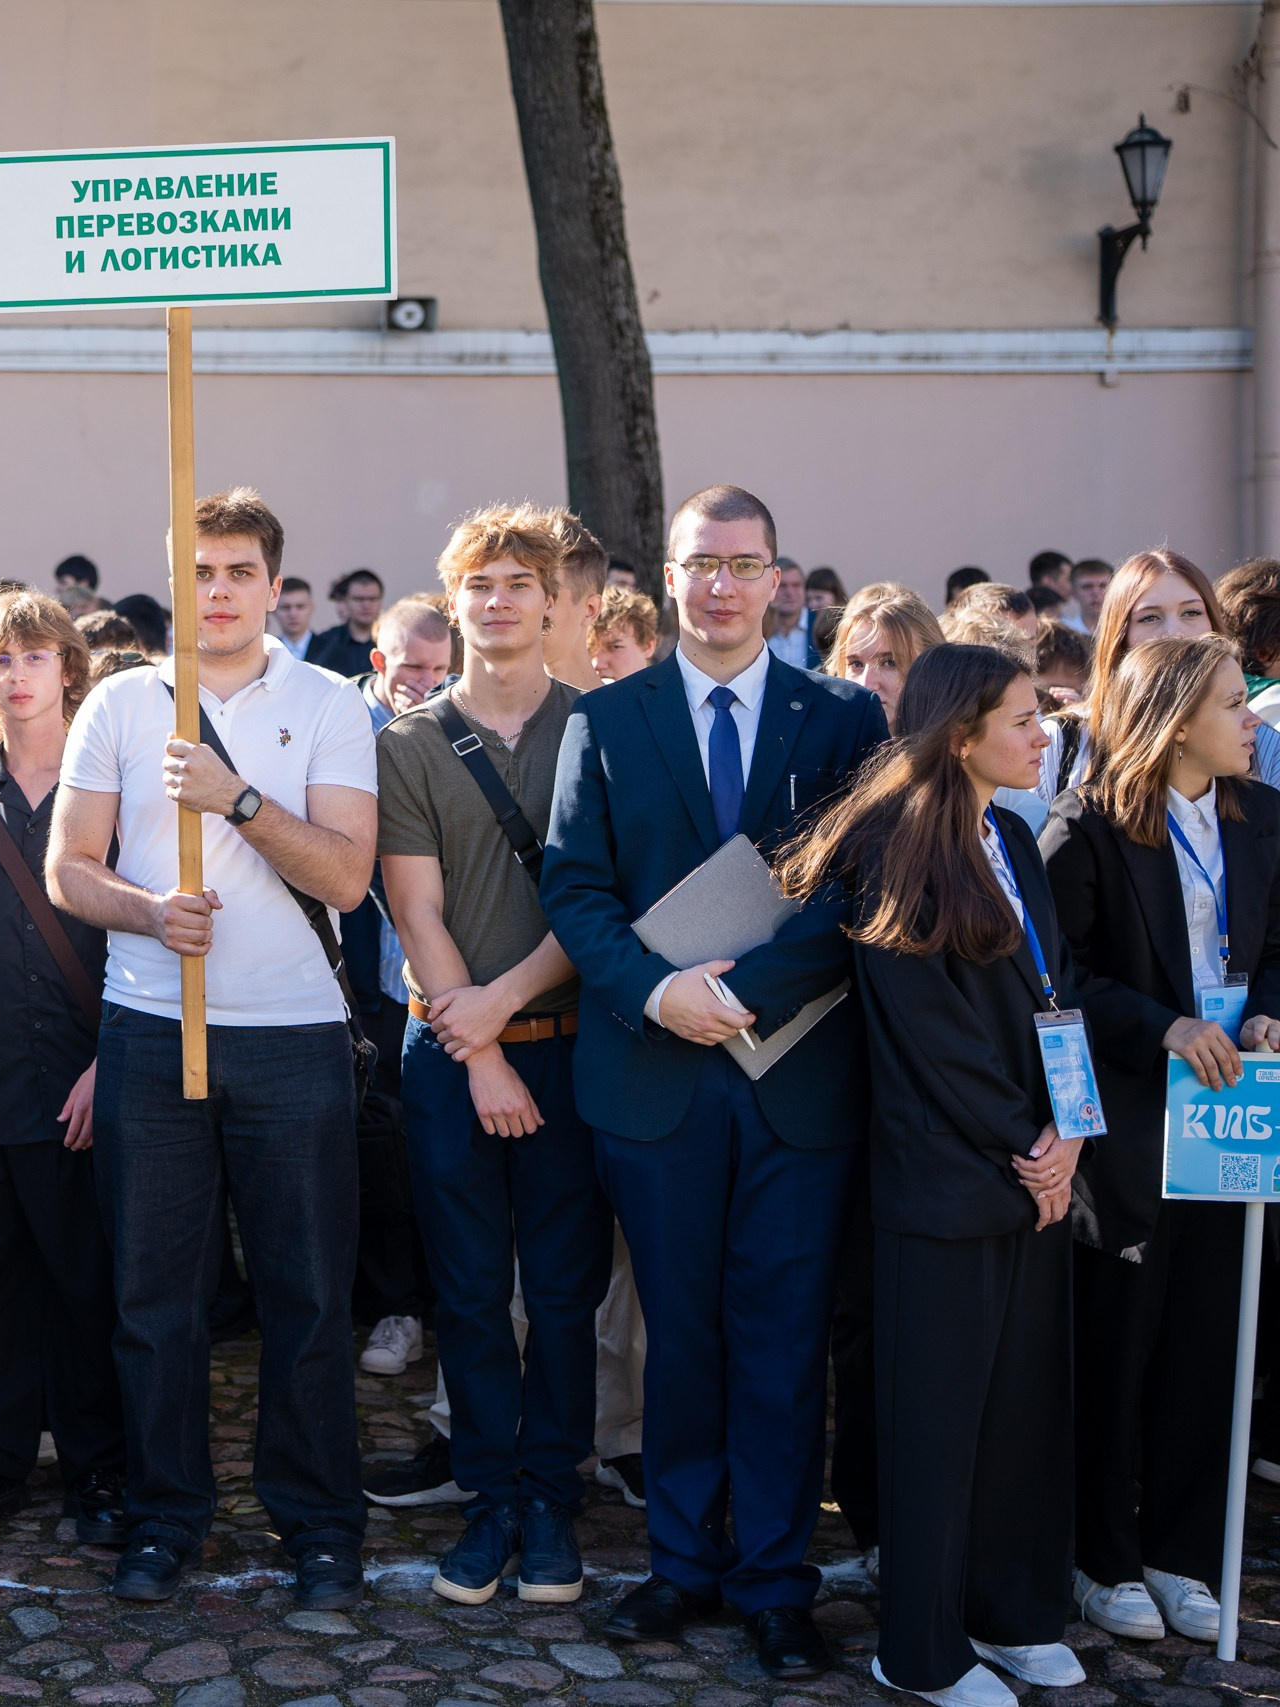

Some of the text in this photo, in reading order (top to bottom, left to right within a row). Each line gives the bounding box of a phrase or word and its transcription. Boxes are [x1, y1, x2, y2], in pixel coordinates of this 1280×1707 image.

[71, 171, 278, 203] УПРАВЛЕНИЕ
[55, 207, 292, 239] ПЕРЕВОЗКАМИ
[64, 242, 282, 274] И ЛОГИСТИКА
